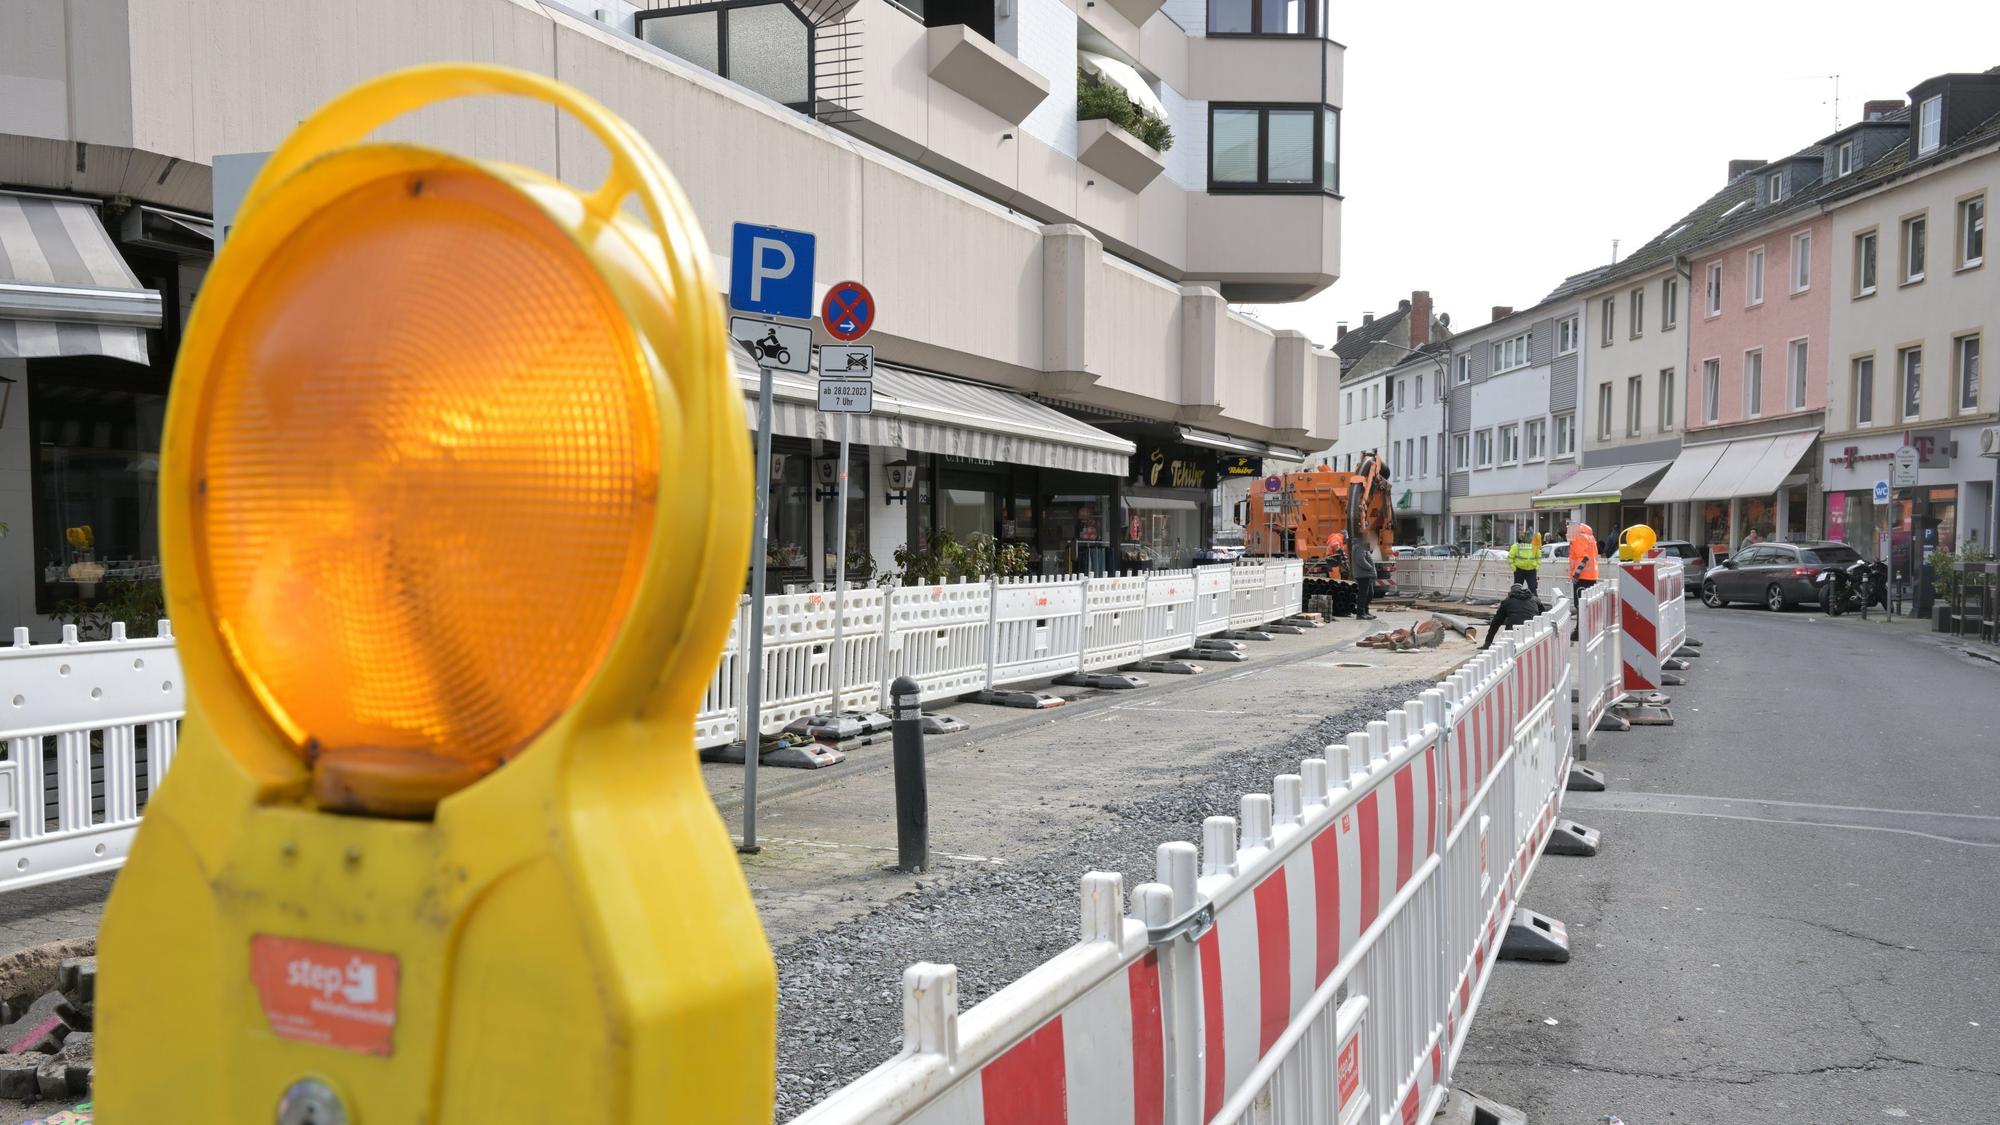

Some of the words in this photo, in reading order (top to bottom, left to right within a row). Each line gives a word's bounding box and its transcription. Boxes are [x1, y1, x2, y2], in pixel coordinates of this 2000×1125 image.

[751, 236, 796, 302] P
[823, 386, 832, 395] ab
[833, 386, 867, 396] 28.02.2023
[836, 397, 840, 406] 7
[842, 397, 854, 406] Uhr
[1171, 460, 1206, 487] Tchibo
[1228, 466, 1255, 475] Tchibo
[1875, 487, 1889, 496] WC
[1925, 528, 1931, 538] P
[287, 958, 343, 998] step
